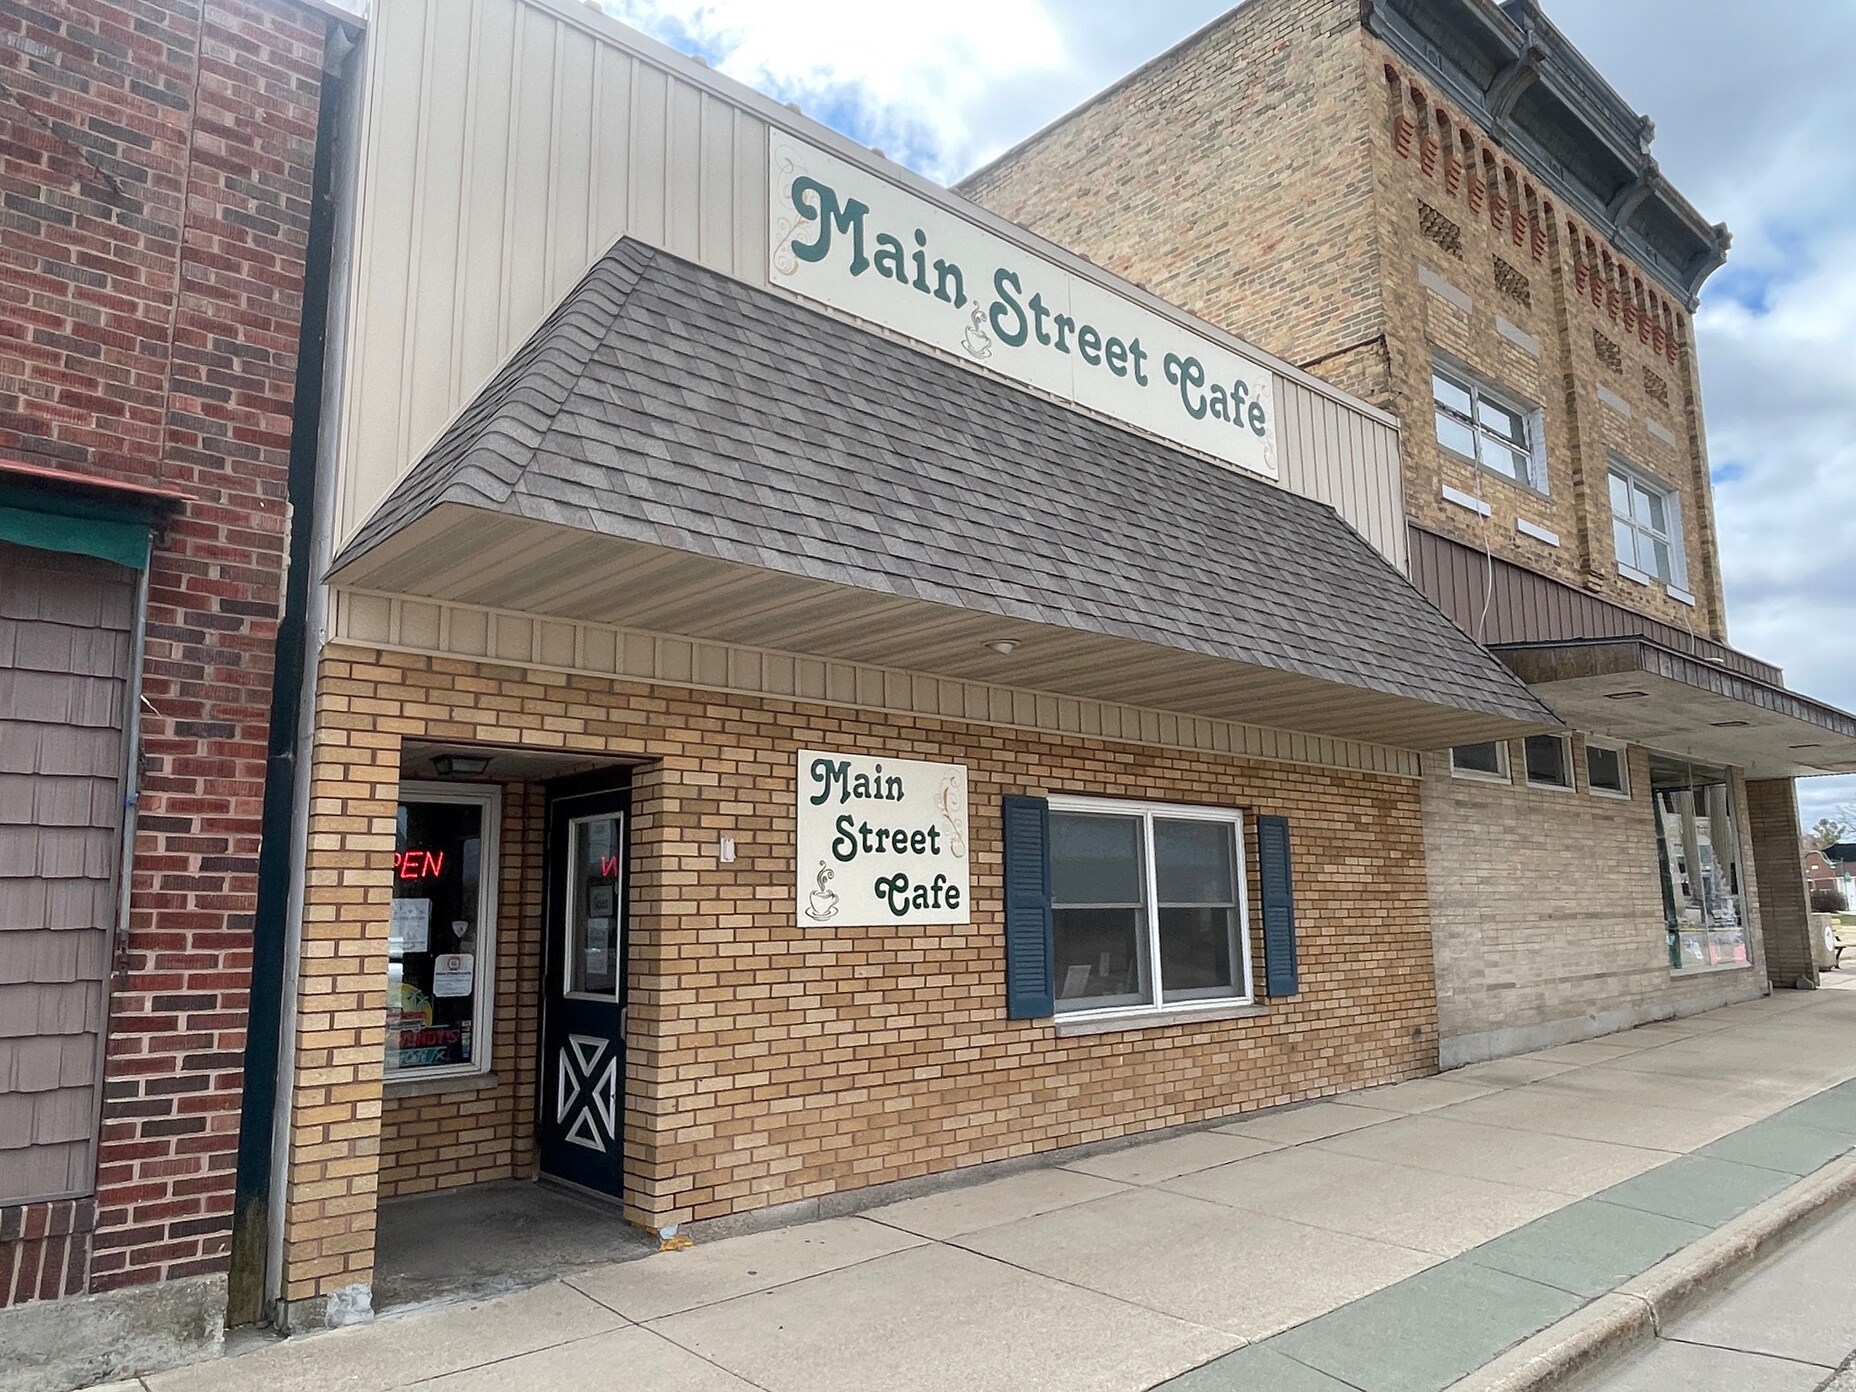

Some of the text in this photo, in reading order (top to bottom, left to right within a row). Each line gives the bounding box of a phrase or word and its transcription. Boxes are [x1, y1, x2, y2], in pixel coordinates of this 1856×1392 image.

[790, 175, 1266, 438] Main Street Cafe
[810, 758, 904, 806] Main
[832, 814, 941, 862] Street
[393, 851, 443, 878] PEN
[875, 872, 961, 917] Cafe
